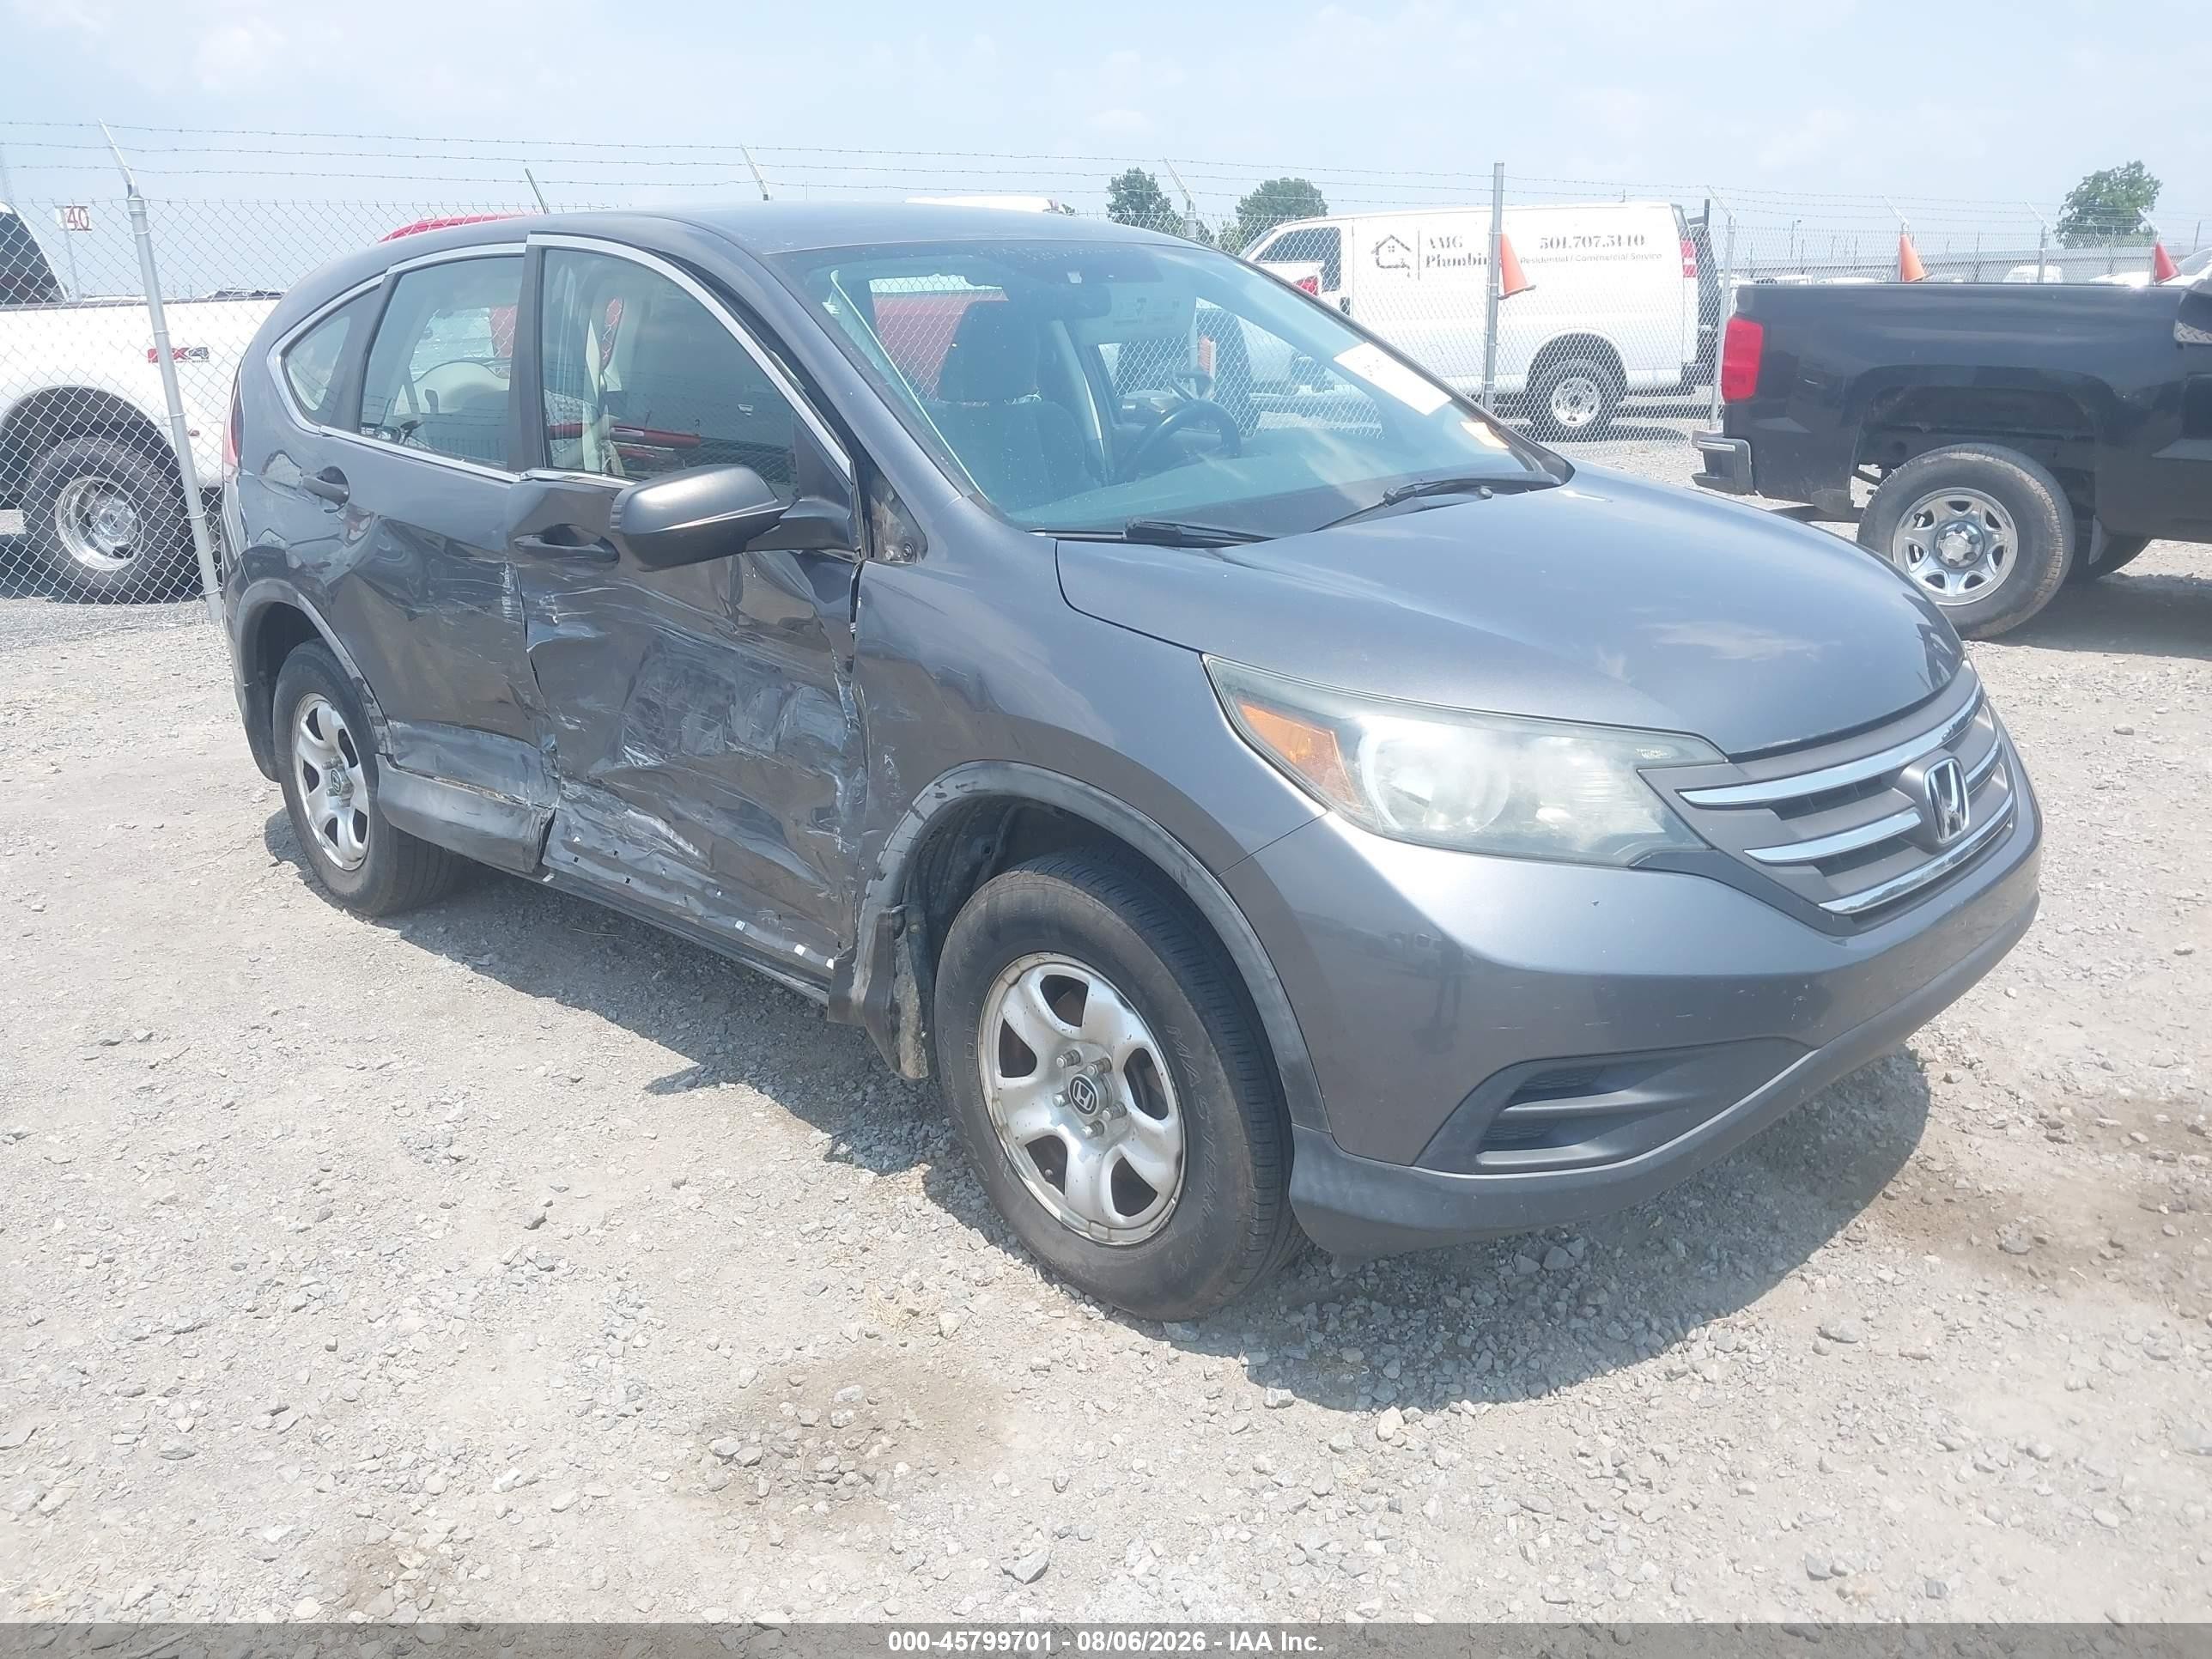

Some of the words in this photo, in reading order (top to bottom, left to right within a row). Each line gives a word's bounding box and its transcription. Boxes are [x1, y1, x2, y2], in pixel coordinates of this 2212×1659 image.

[67, 207, 90, 231] 40
[1426, 252, 1489, 268] Plumbin
[1520, 254, 1569, 264] Residential
[1576, 253, 1628, 262] Commercial
